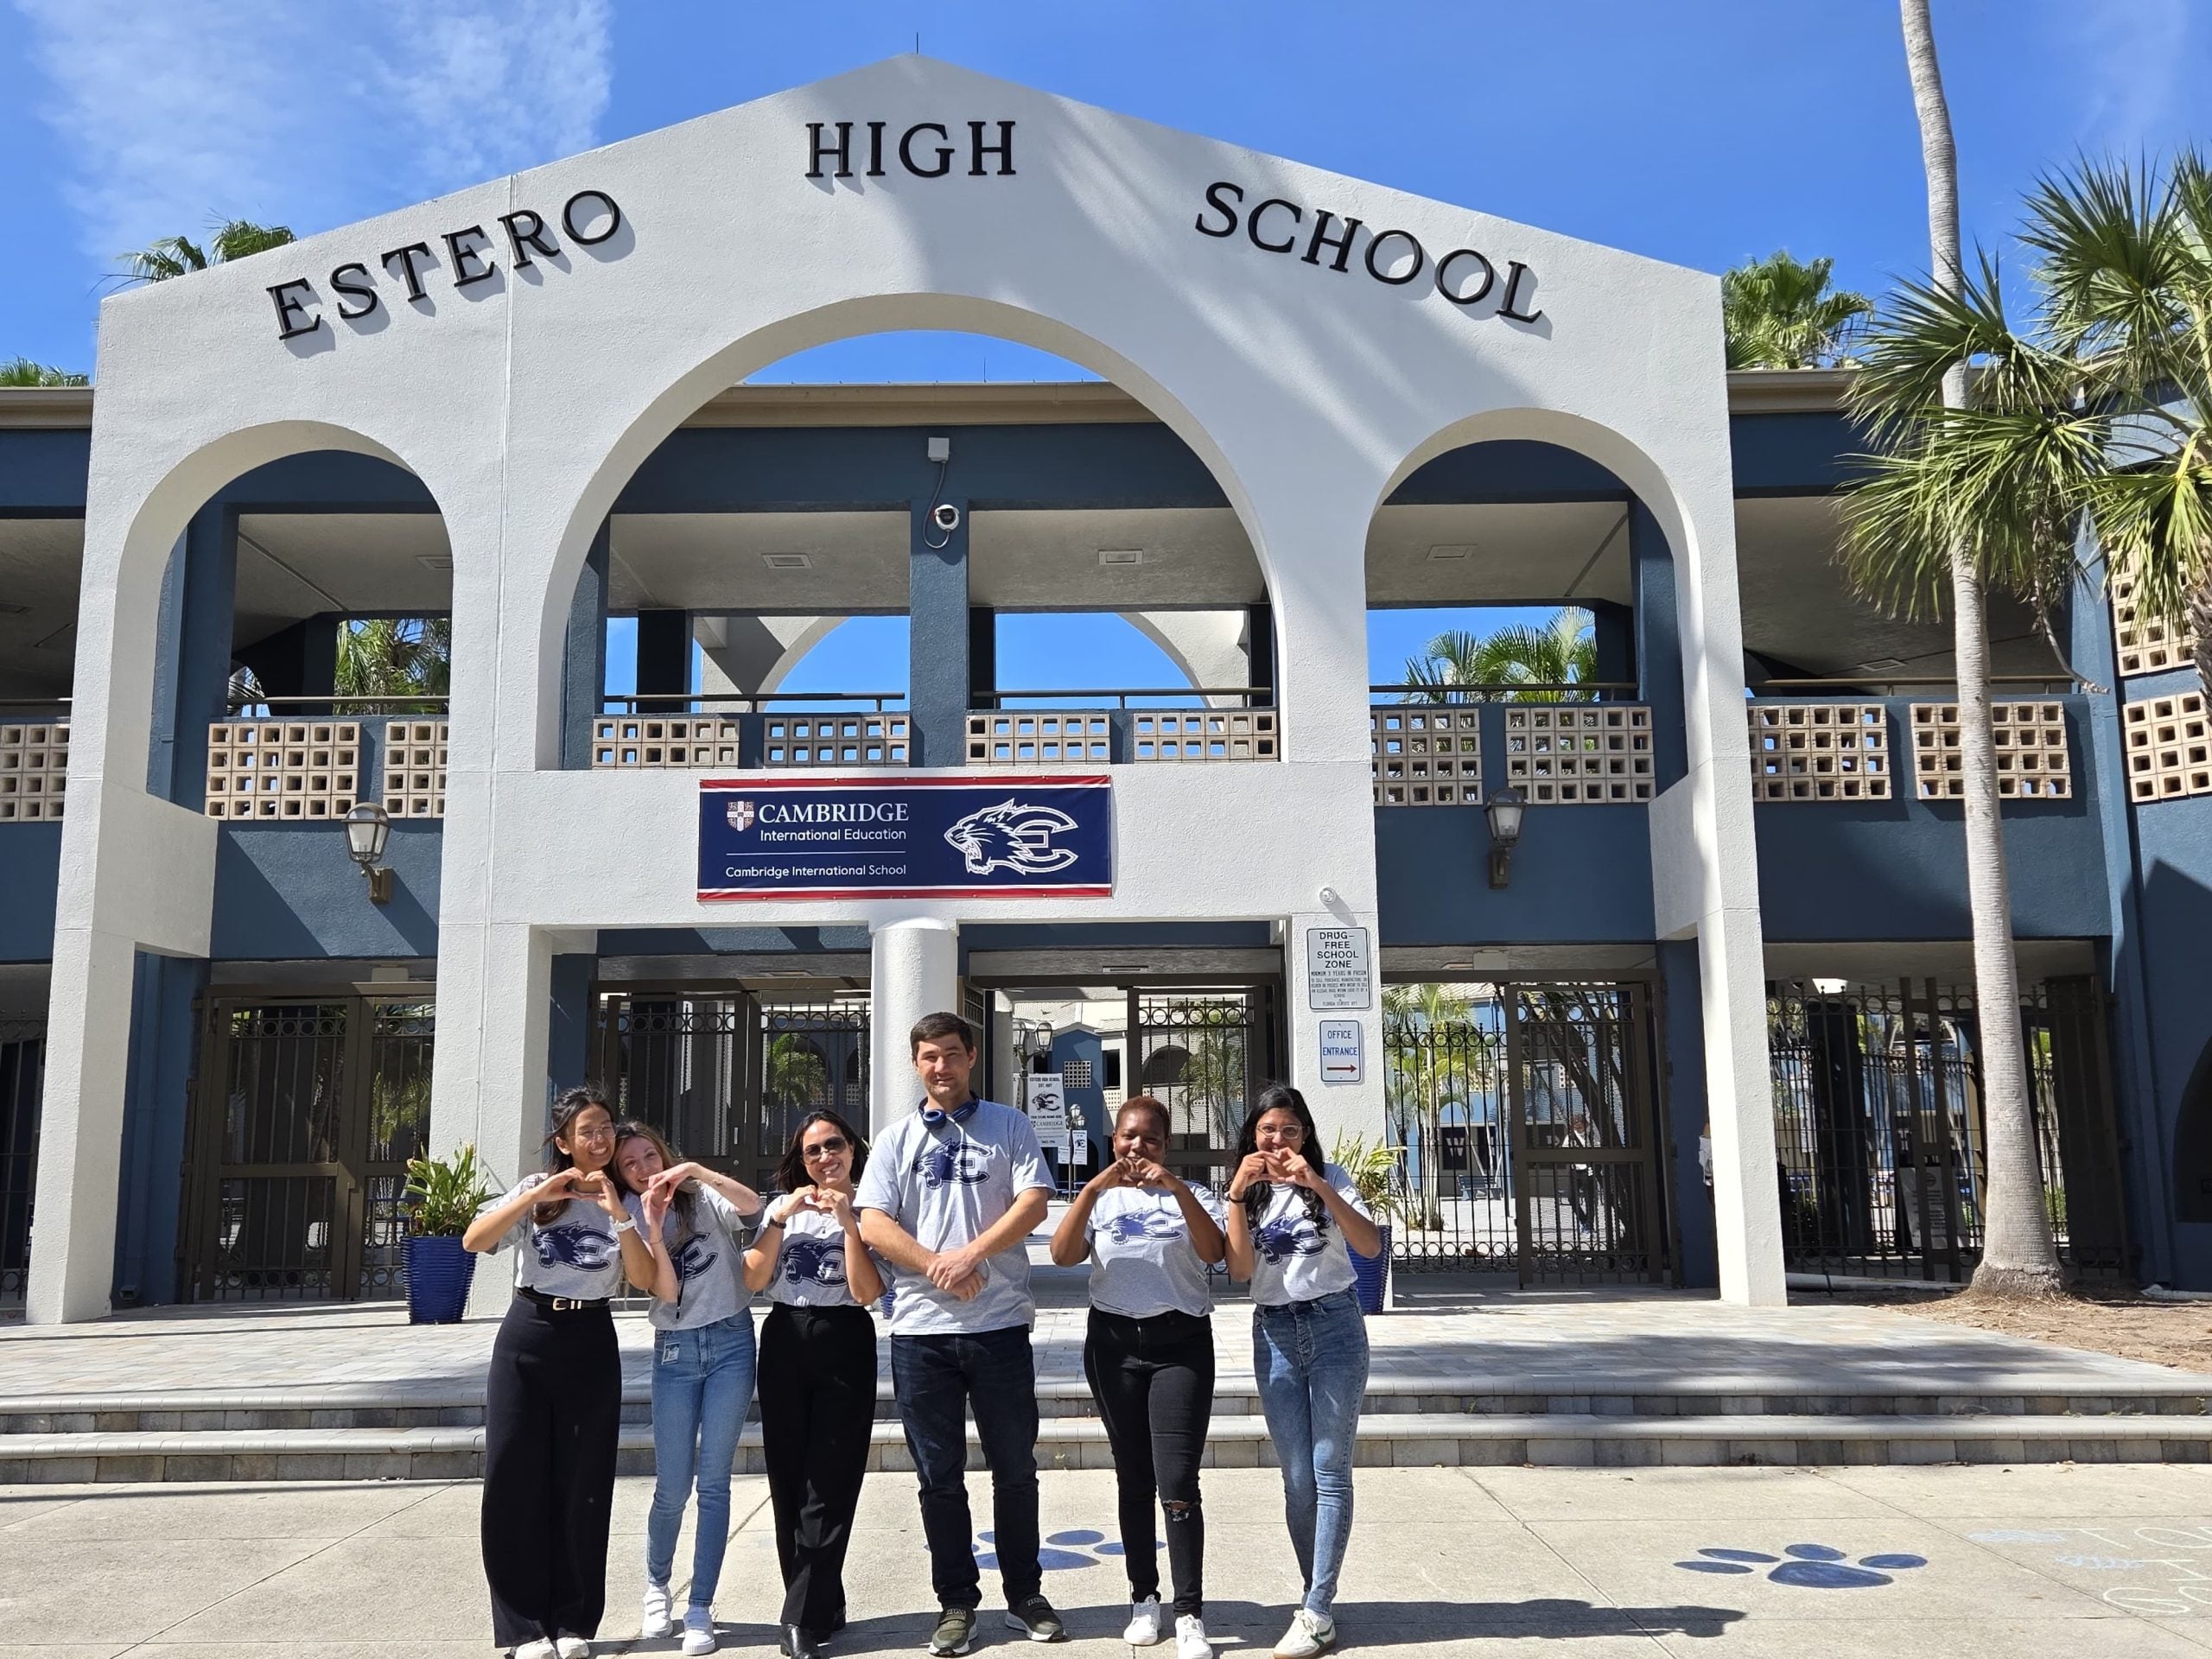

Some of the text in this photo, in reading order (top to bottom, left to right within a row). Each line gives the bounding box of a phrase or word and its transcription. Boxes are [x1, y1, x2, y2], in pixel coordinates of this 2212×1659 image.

[266, 121, 1542, 340] ESTERO HIGH SCHOOL
[759, 803, 909, 823] CAMBRIDGE
[760, 828, 906, 842] International Education
[726, 864, 906, 879] Cambridge International School
[1317, 950, 1359, 959] SCHOOL
[1327, 1030, 1352, 1039] OFFICE
[1323, 1046, 1358, 1056] ENTRANCE
